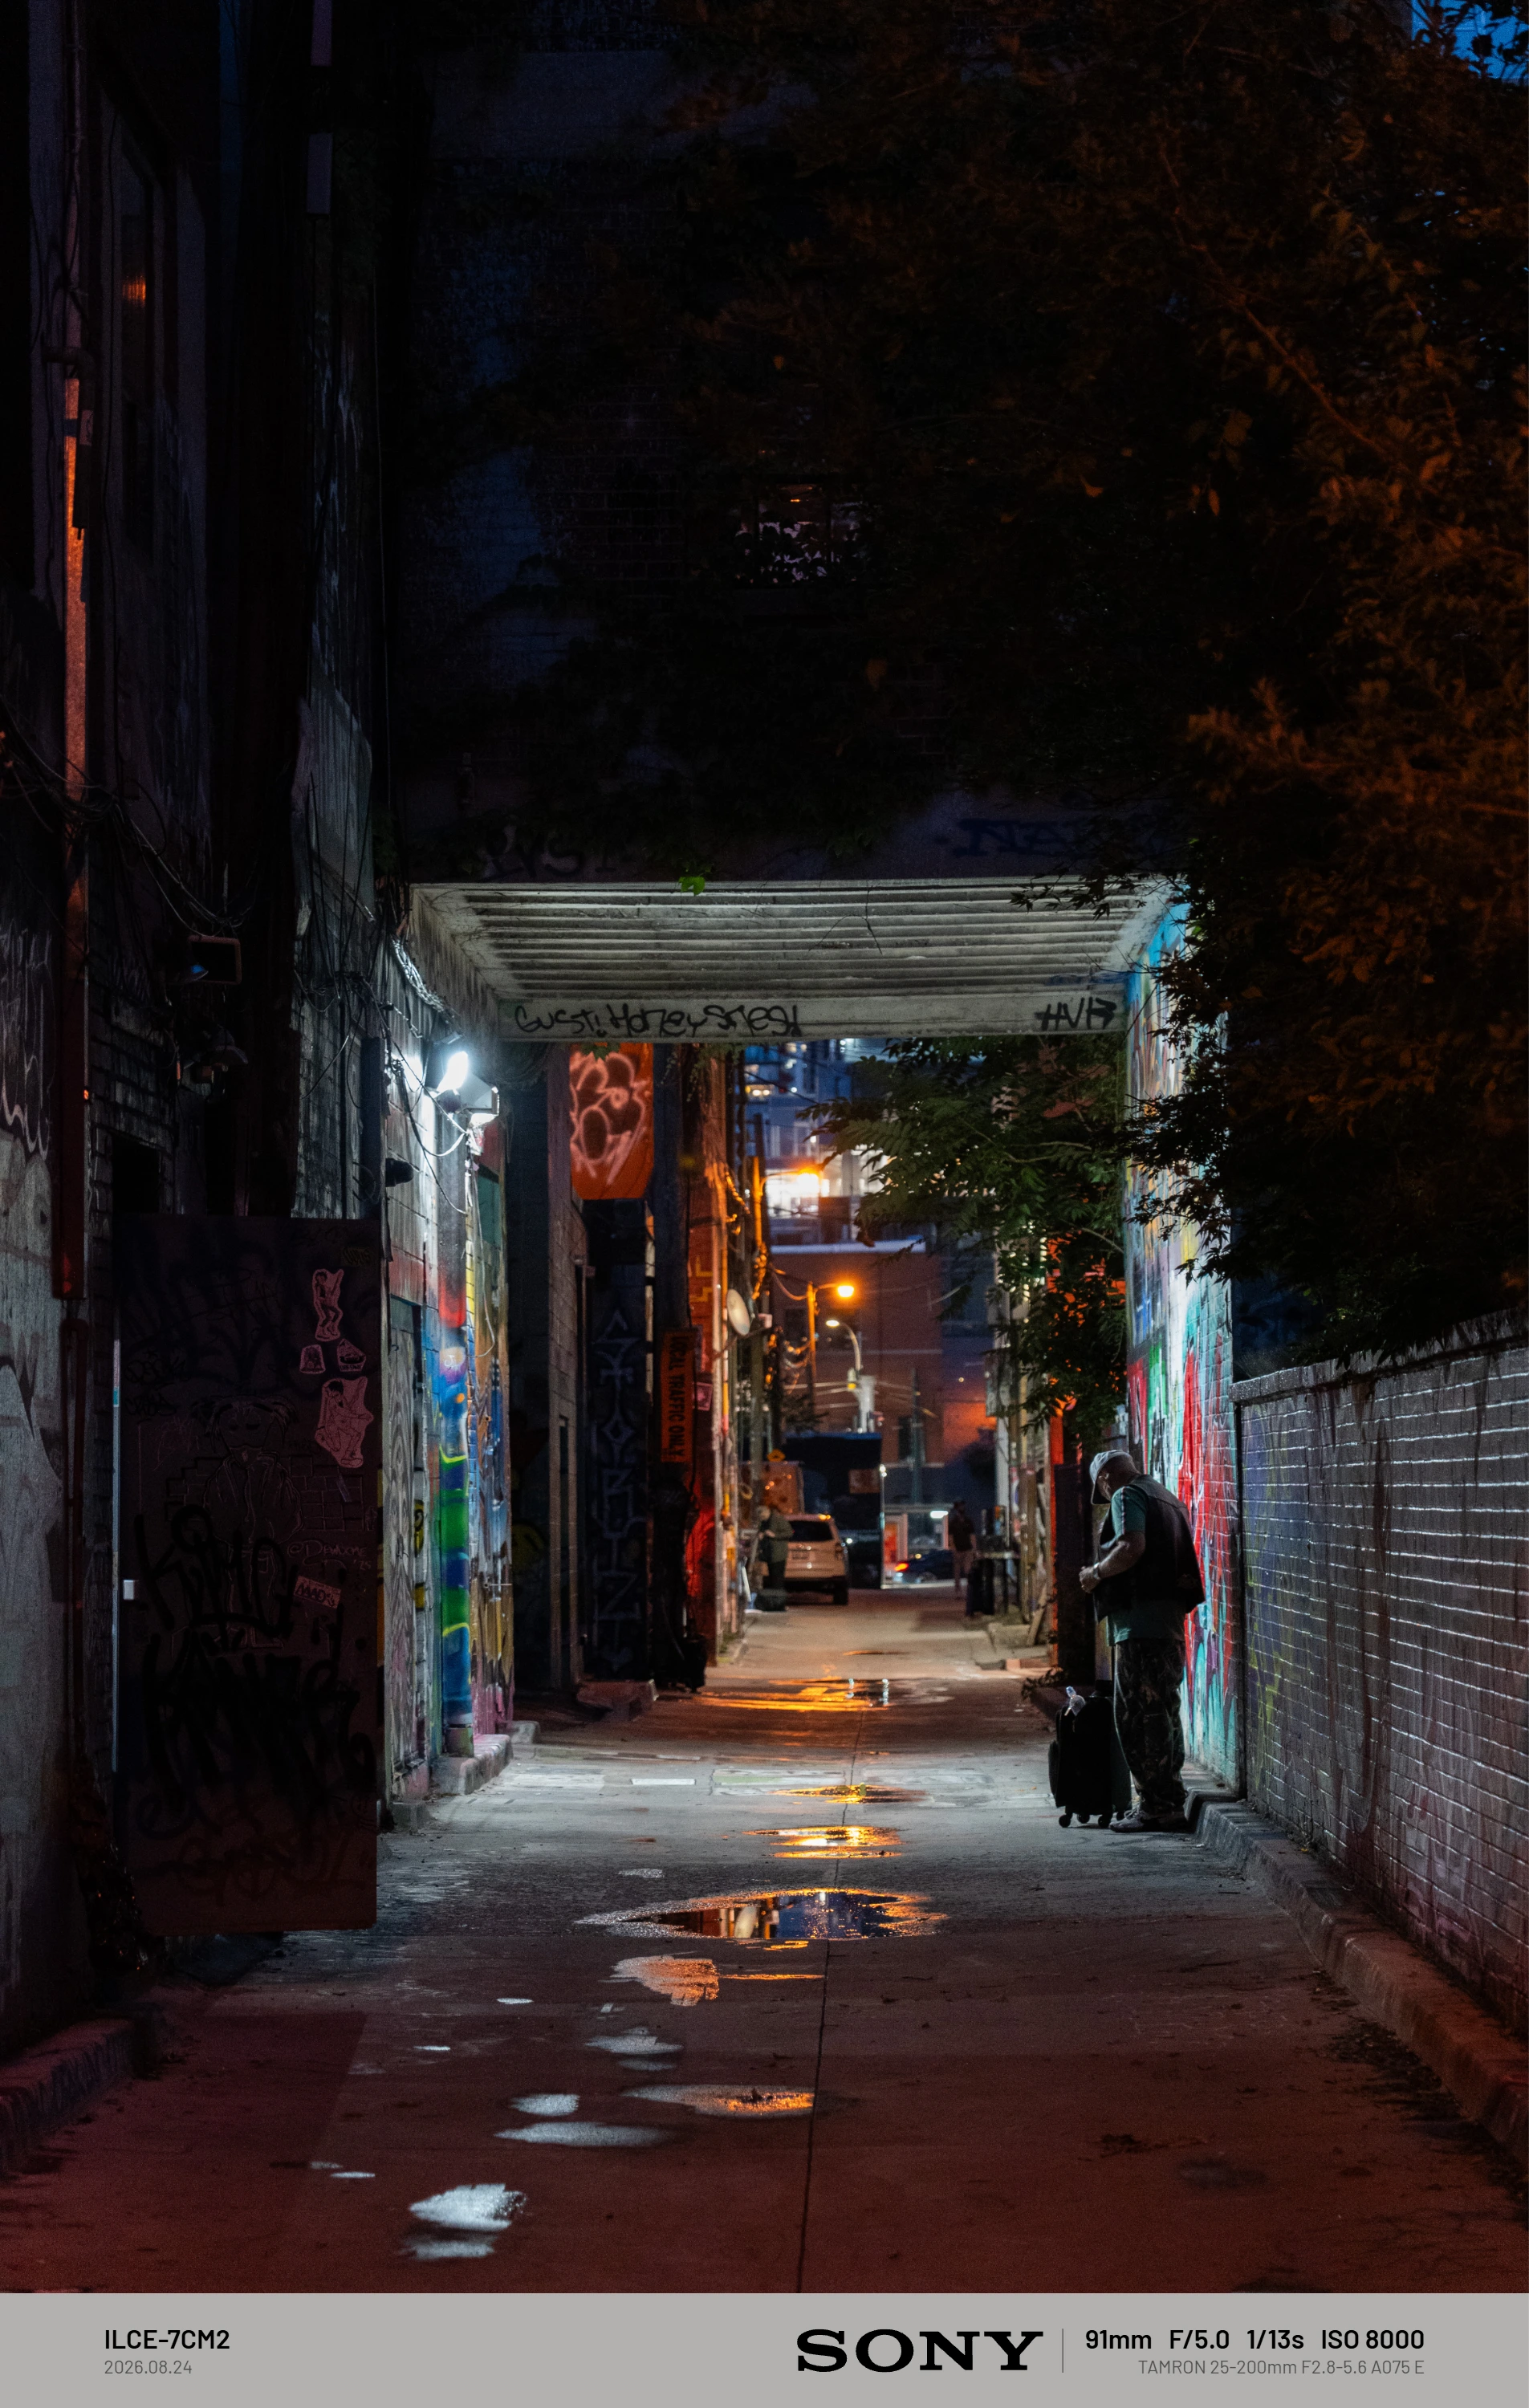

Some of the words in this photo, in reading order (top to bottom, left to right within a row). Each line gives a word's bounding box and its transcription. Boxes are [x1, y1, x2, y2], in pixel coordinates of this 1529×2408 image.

[669, 1335, 688, 1370] LOCAL
[669, 1373, 685, 1422] TRAFFIC
[668, 1425, 685, 1456] ONLY
